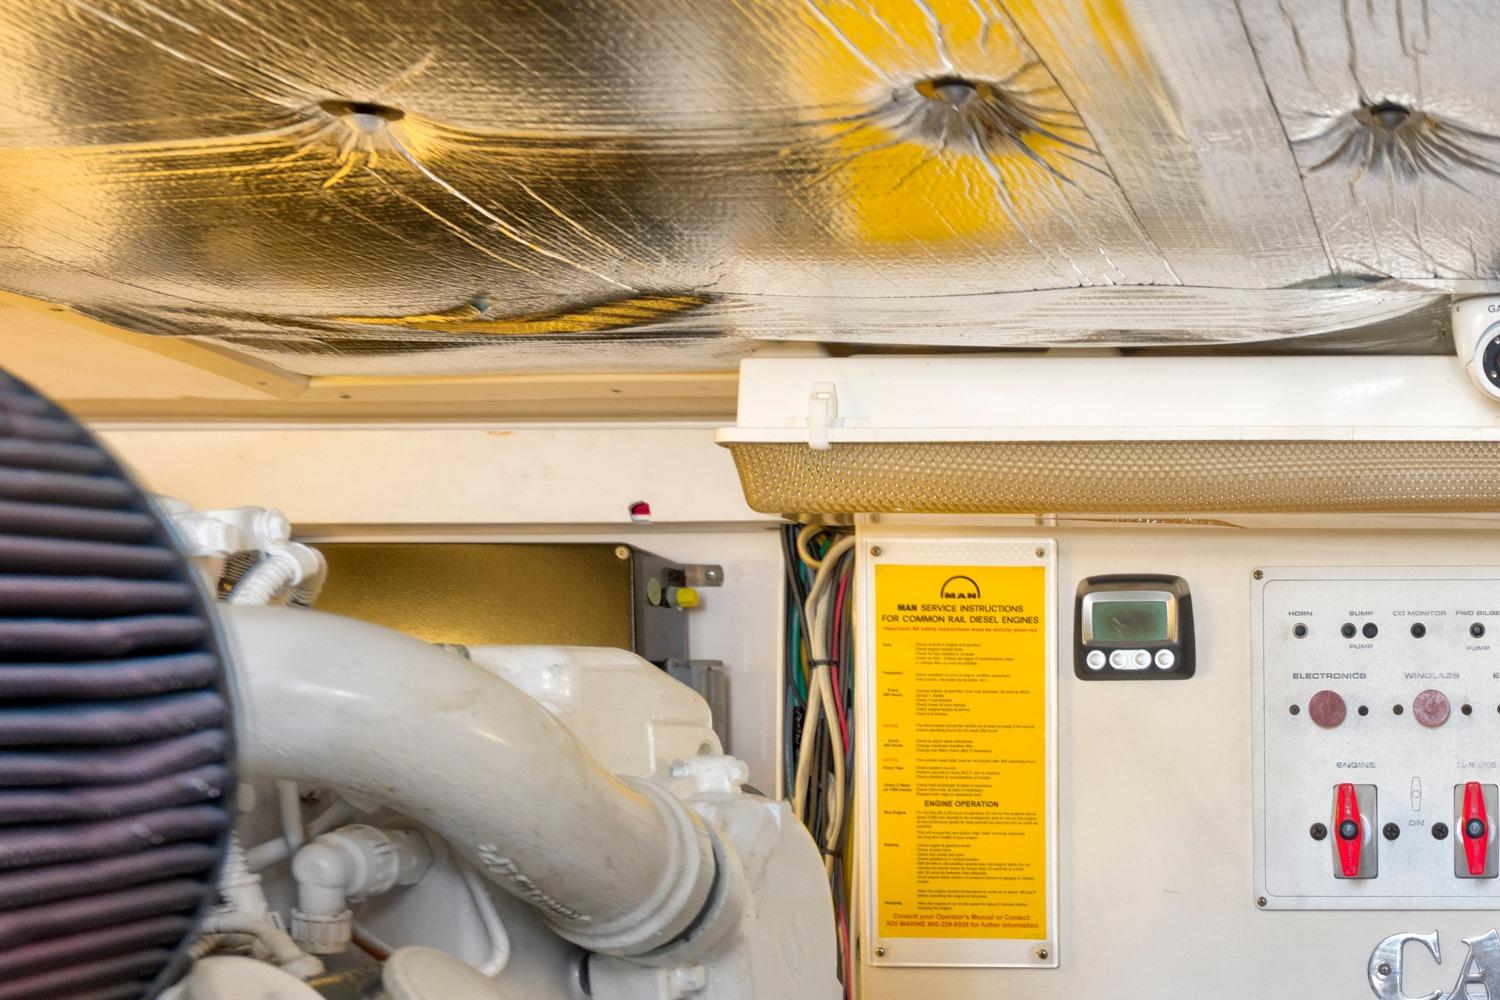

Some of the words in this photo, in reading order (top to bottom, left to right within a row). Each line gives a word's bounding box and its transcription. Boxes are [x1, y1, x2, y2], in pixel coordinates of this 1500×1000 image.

[921, 604, 956, 612] SERVICE
[960, 605, 1023, 613] INSTRUCTIONS
[903, 615, 945, 623] COMMON
[970, 616, 999, 624] DIESEL
[1292, 672, 1367, 680] ELECTRONICS
[955, 800, 999, 808] OPERATION
